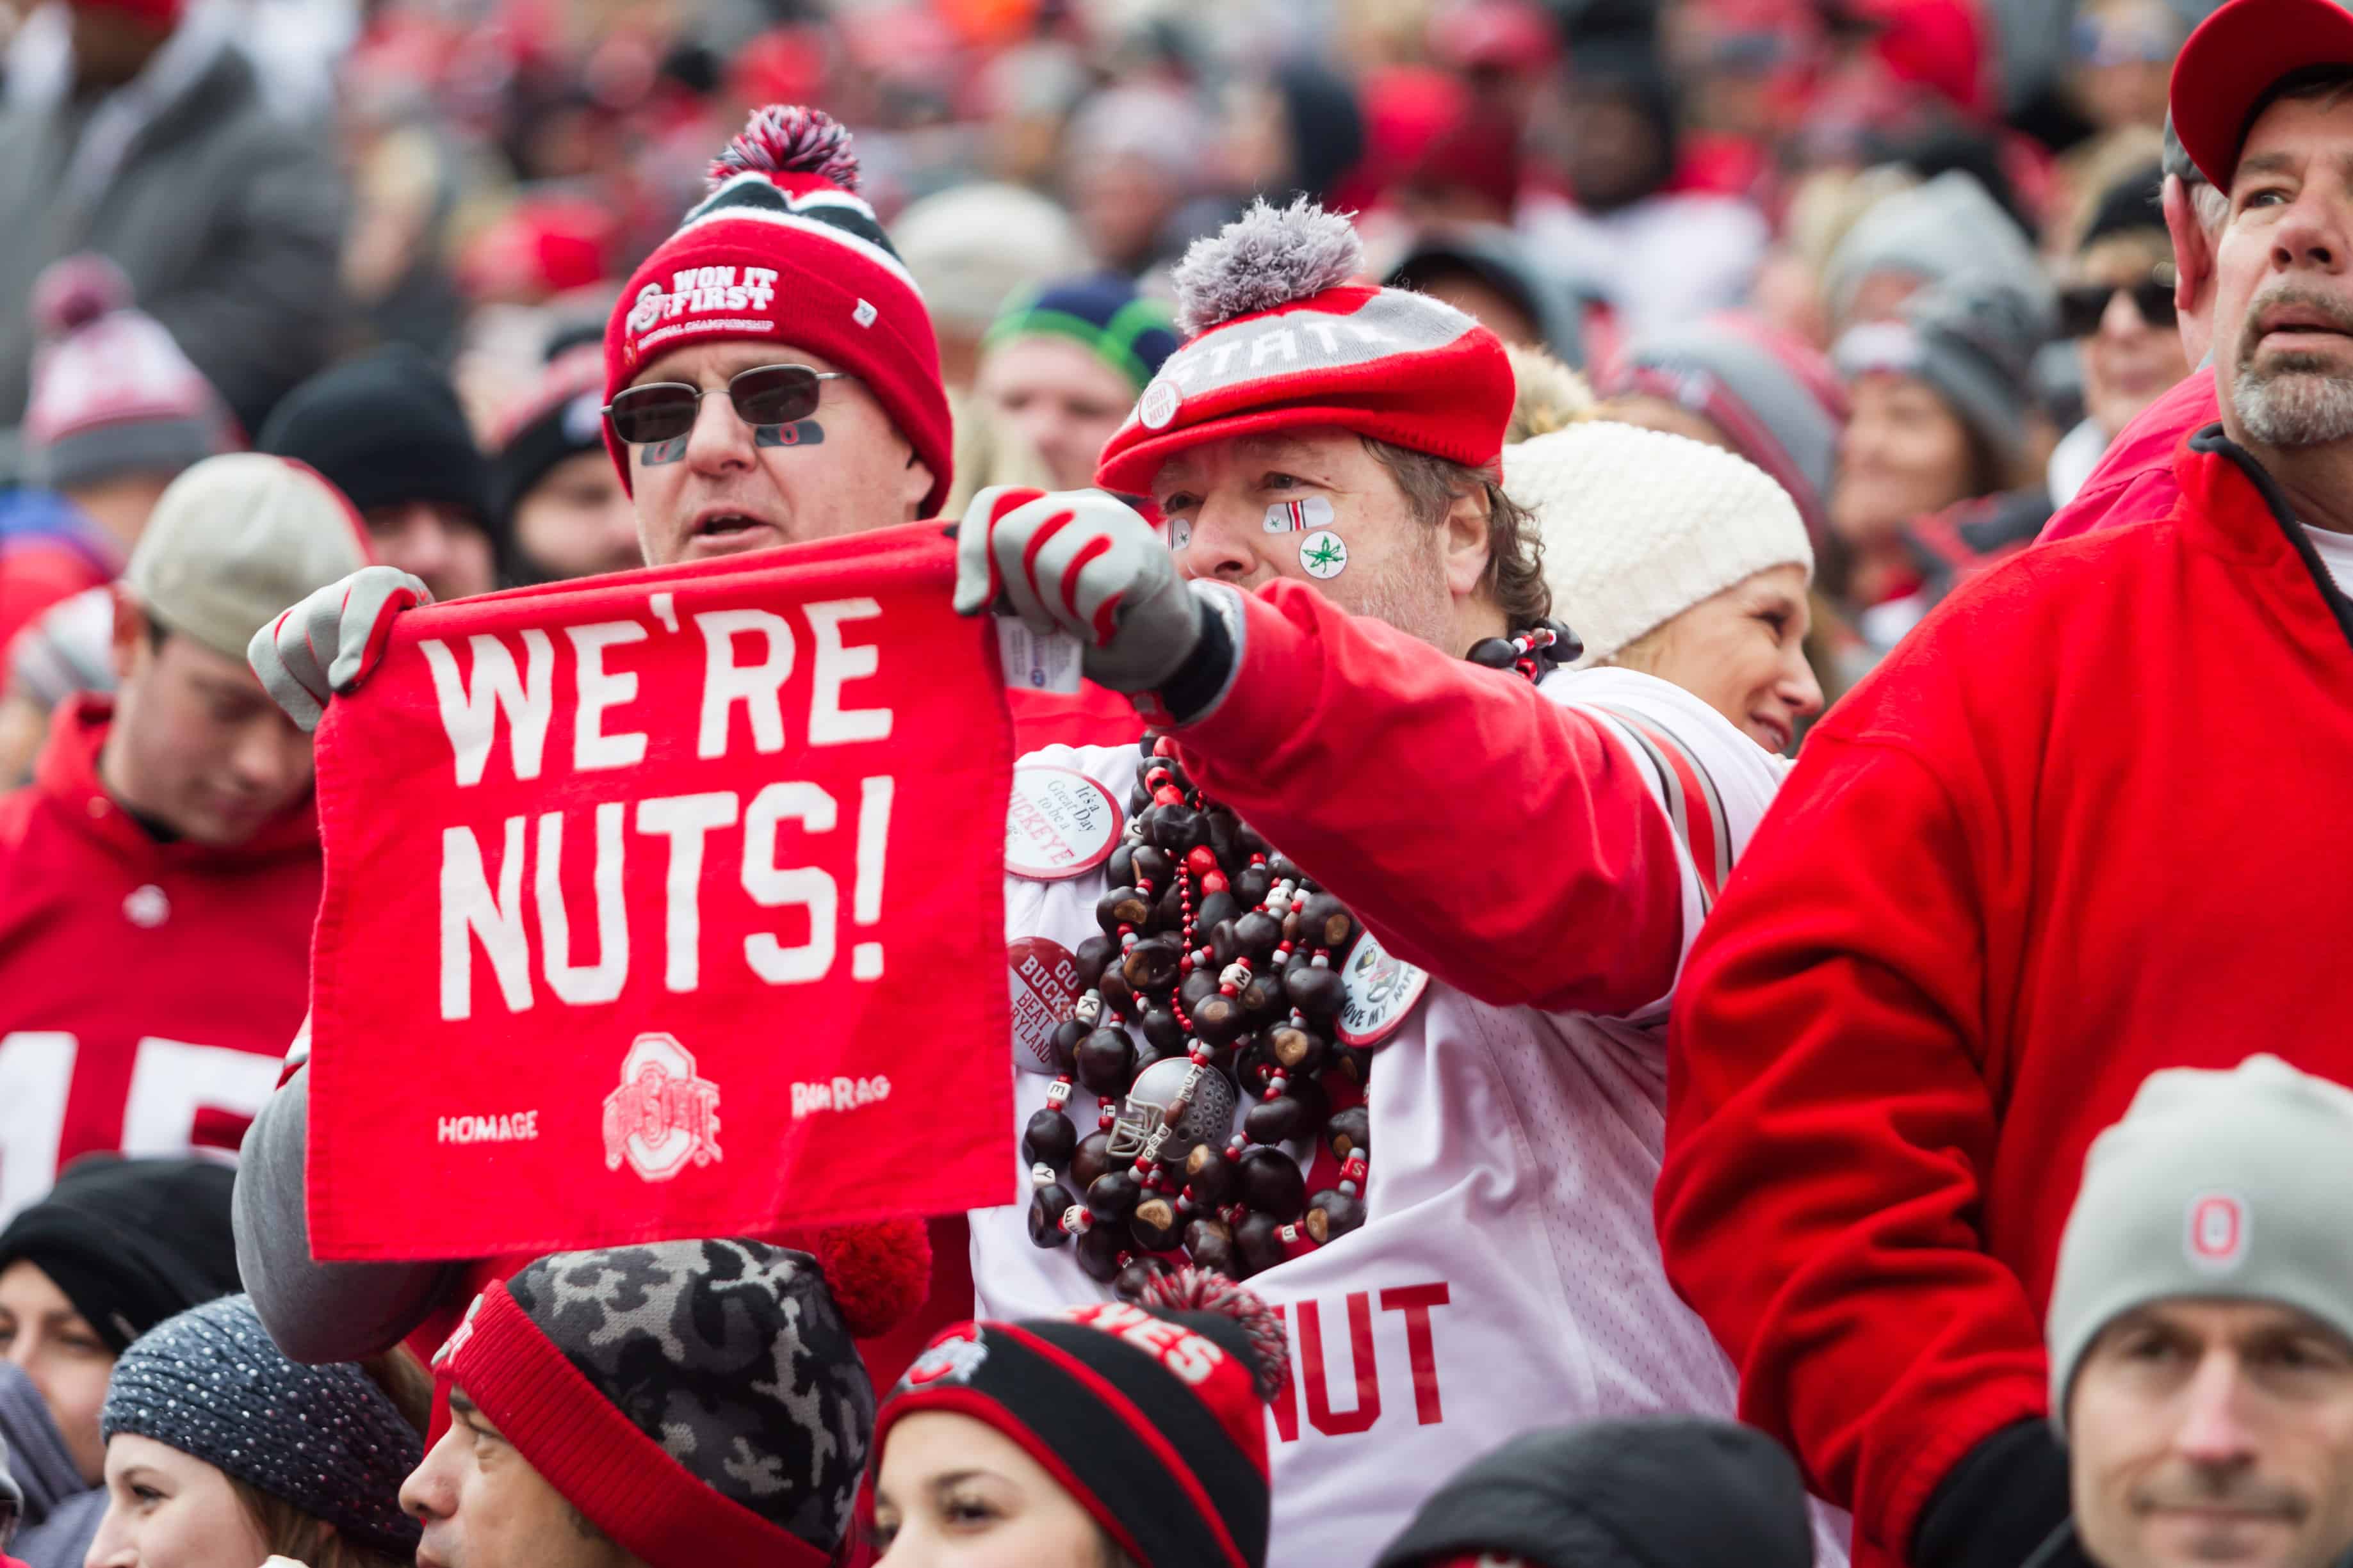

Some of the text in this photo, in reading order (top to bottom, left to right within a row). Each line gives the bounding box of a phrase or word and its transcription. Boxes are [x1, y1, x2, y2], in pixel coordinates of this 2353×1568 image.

[671, 286, 774, 318] FIRST
[673, 266, 778, 291] WON IT
[419, 593, 893, 787] WE'RE
[1011, 792, 1075, 864] UCKEYE
[1073, 808, 1096, 832] Day
[439, 775, 894, 1021] NUTS!
[1019, 954, 1077, 1022] BUCKS
[1055, 959, 1079, 990] GO
[1016, 989, 1054, 1031] BEAT
[1082, 999, 1097, 1012] K
[1011, 1007, 1051, 1064] RYLAND
[438, 1110, 539, 1144] HOMAGE
[1145, 1065, 1203, 1158] OSU NUT
[1086, 1302, 1224, 1385] YES
